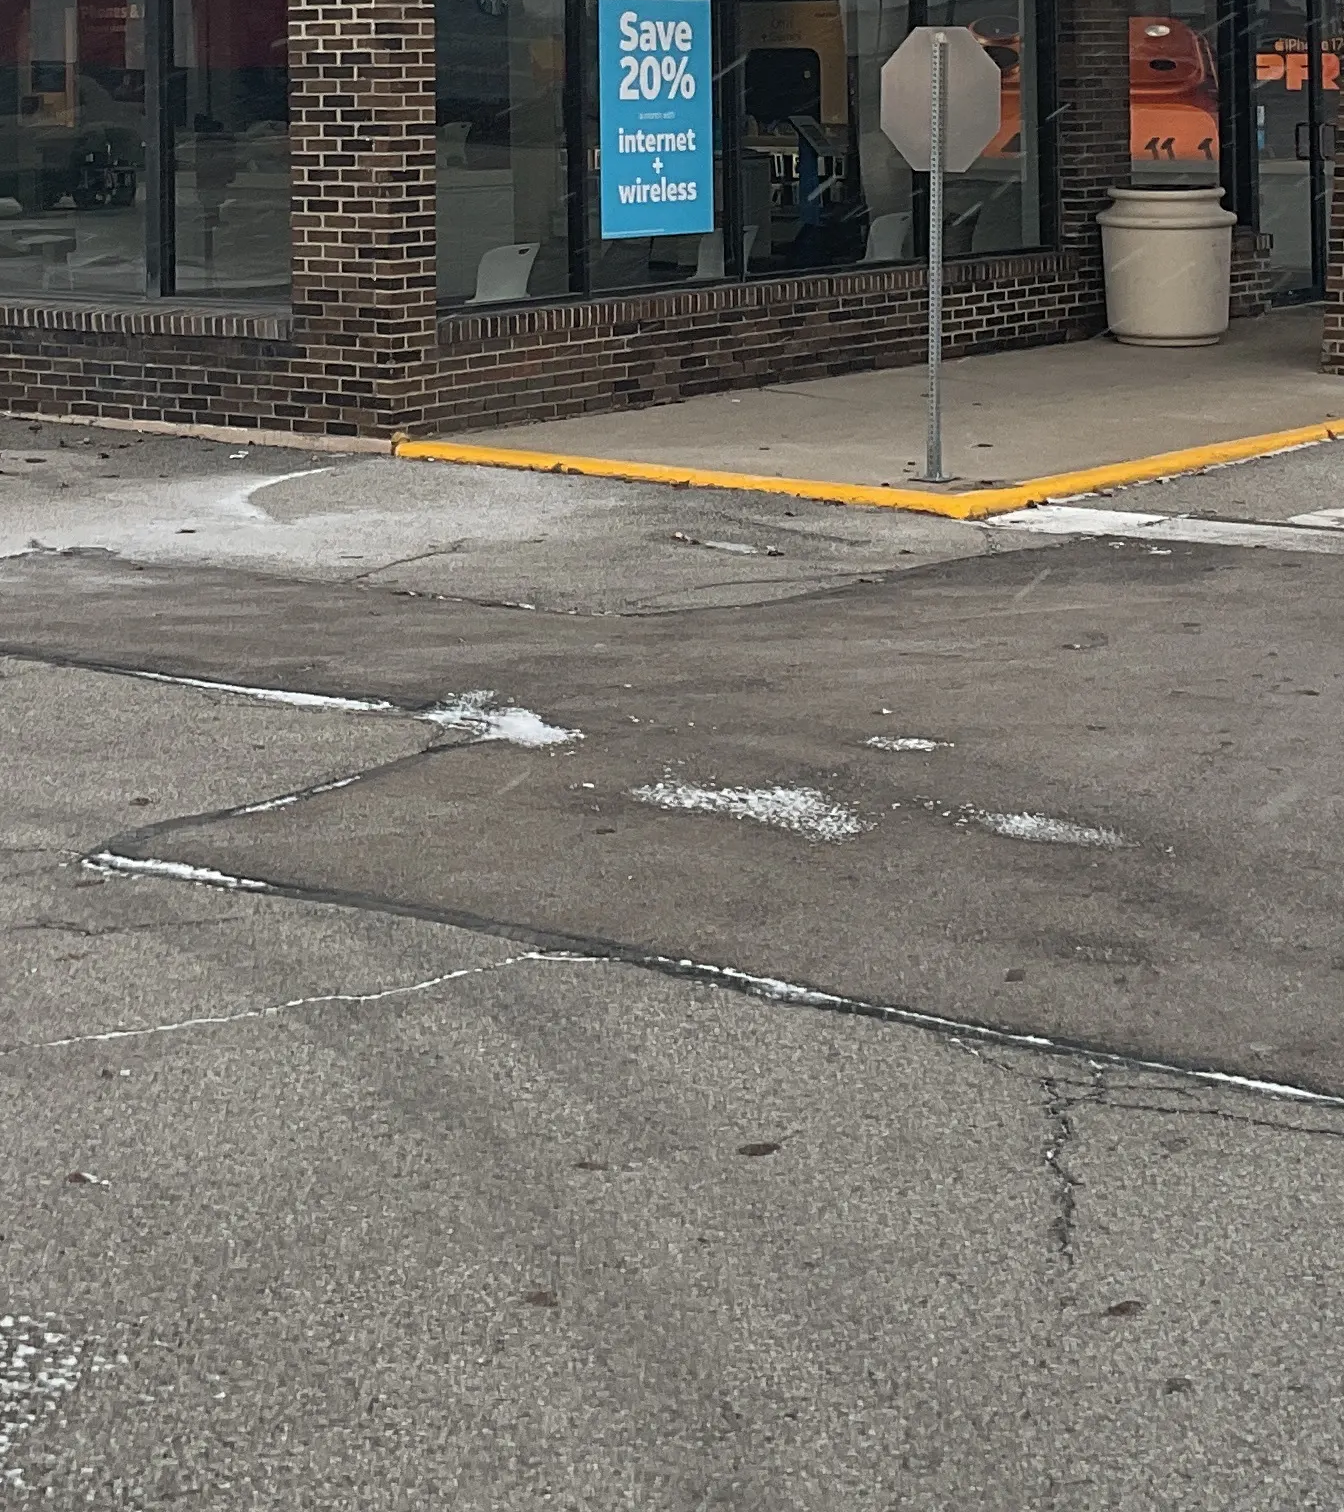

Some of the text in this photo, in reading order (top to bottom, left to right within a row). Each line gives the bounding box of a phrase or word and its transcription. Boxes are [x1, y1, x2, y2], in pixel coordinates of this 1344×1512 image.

[619, 11, 693, 52] Save
[619, 55, 696, 100] 20%
[618, 128, 696, 153] internet
[619, 177, 697, 204] wireless
